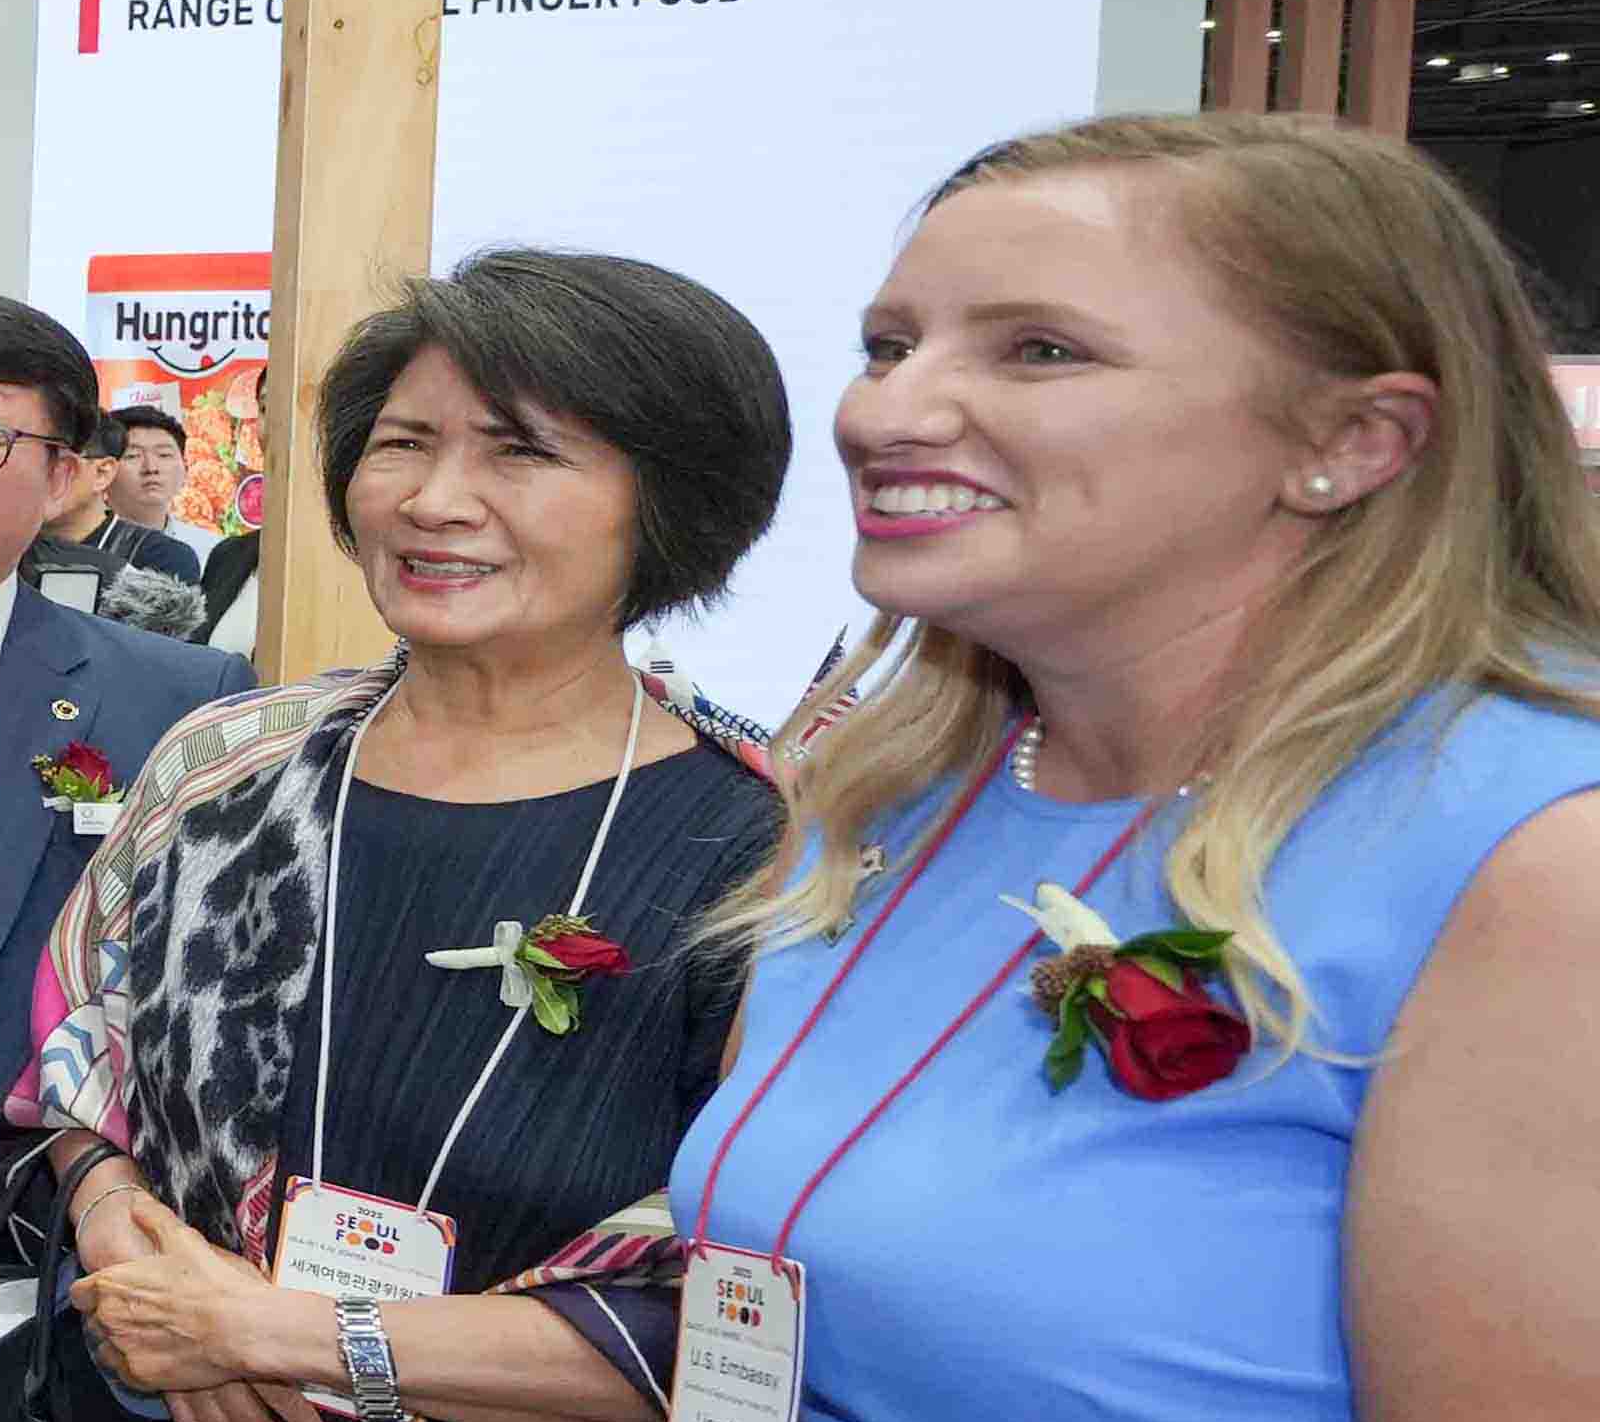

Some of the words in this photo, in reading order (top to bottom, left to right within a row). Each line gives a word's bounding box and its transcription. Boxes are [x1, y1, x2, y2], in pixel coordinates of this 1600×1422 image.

[335, 1212, 401, 1242] SEOUL
[716, 1277, 766, 1307] SEOUL
[719, 1356, 781, 1391] Embassy
